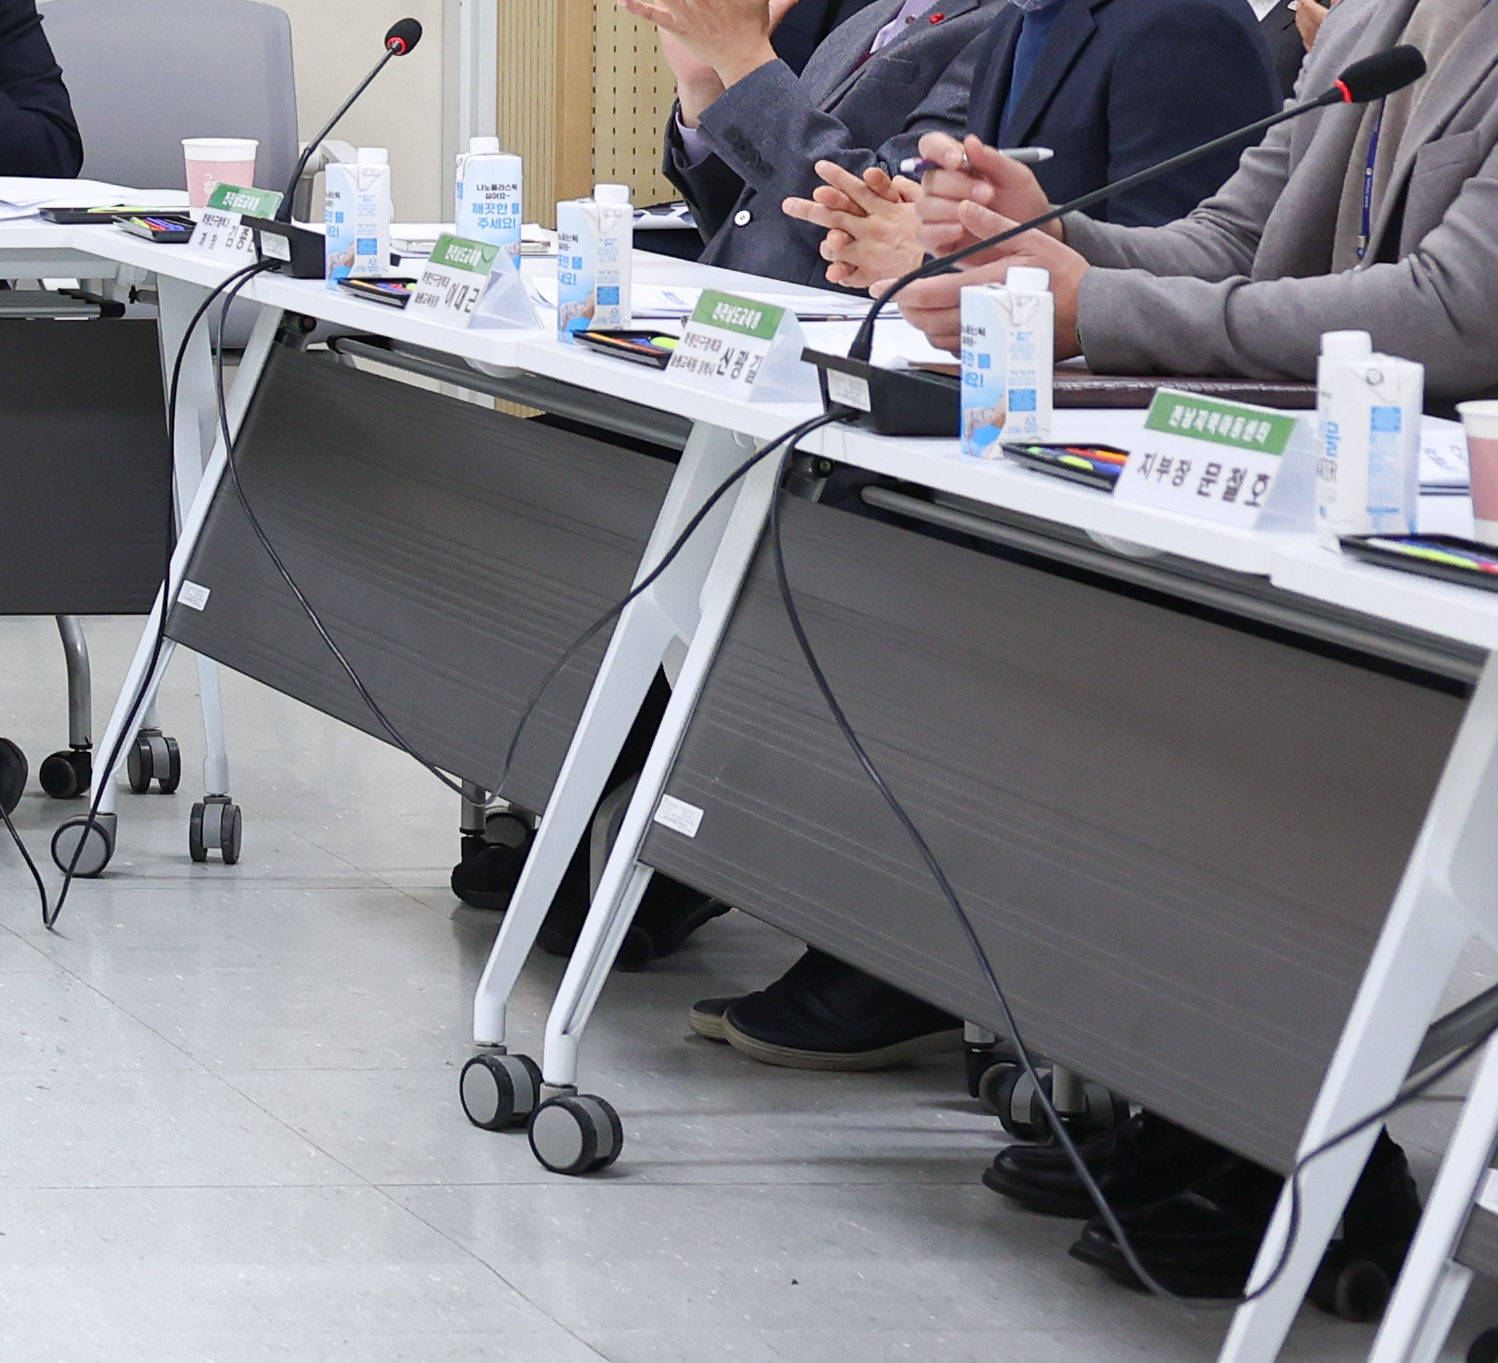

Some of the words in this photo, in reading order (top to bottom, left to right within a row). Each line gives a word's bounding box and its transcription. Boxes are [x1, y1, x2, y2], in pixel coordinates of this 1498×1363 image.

[471, 202, 508, 215] 깨끗한
[477, 217, 516, 229] 주세요!
[1137, 451, 1193, 488] 지부장
